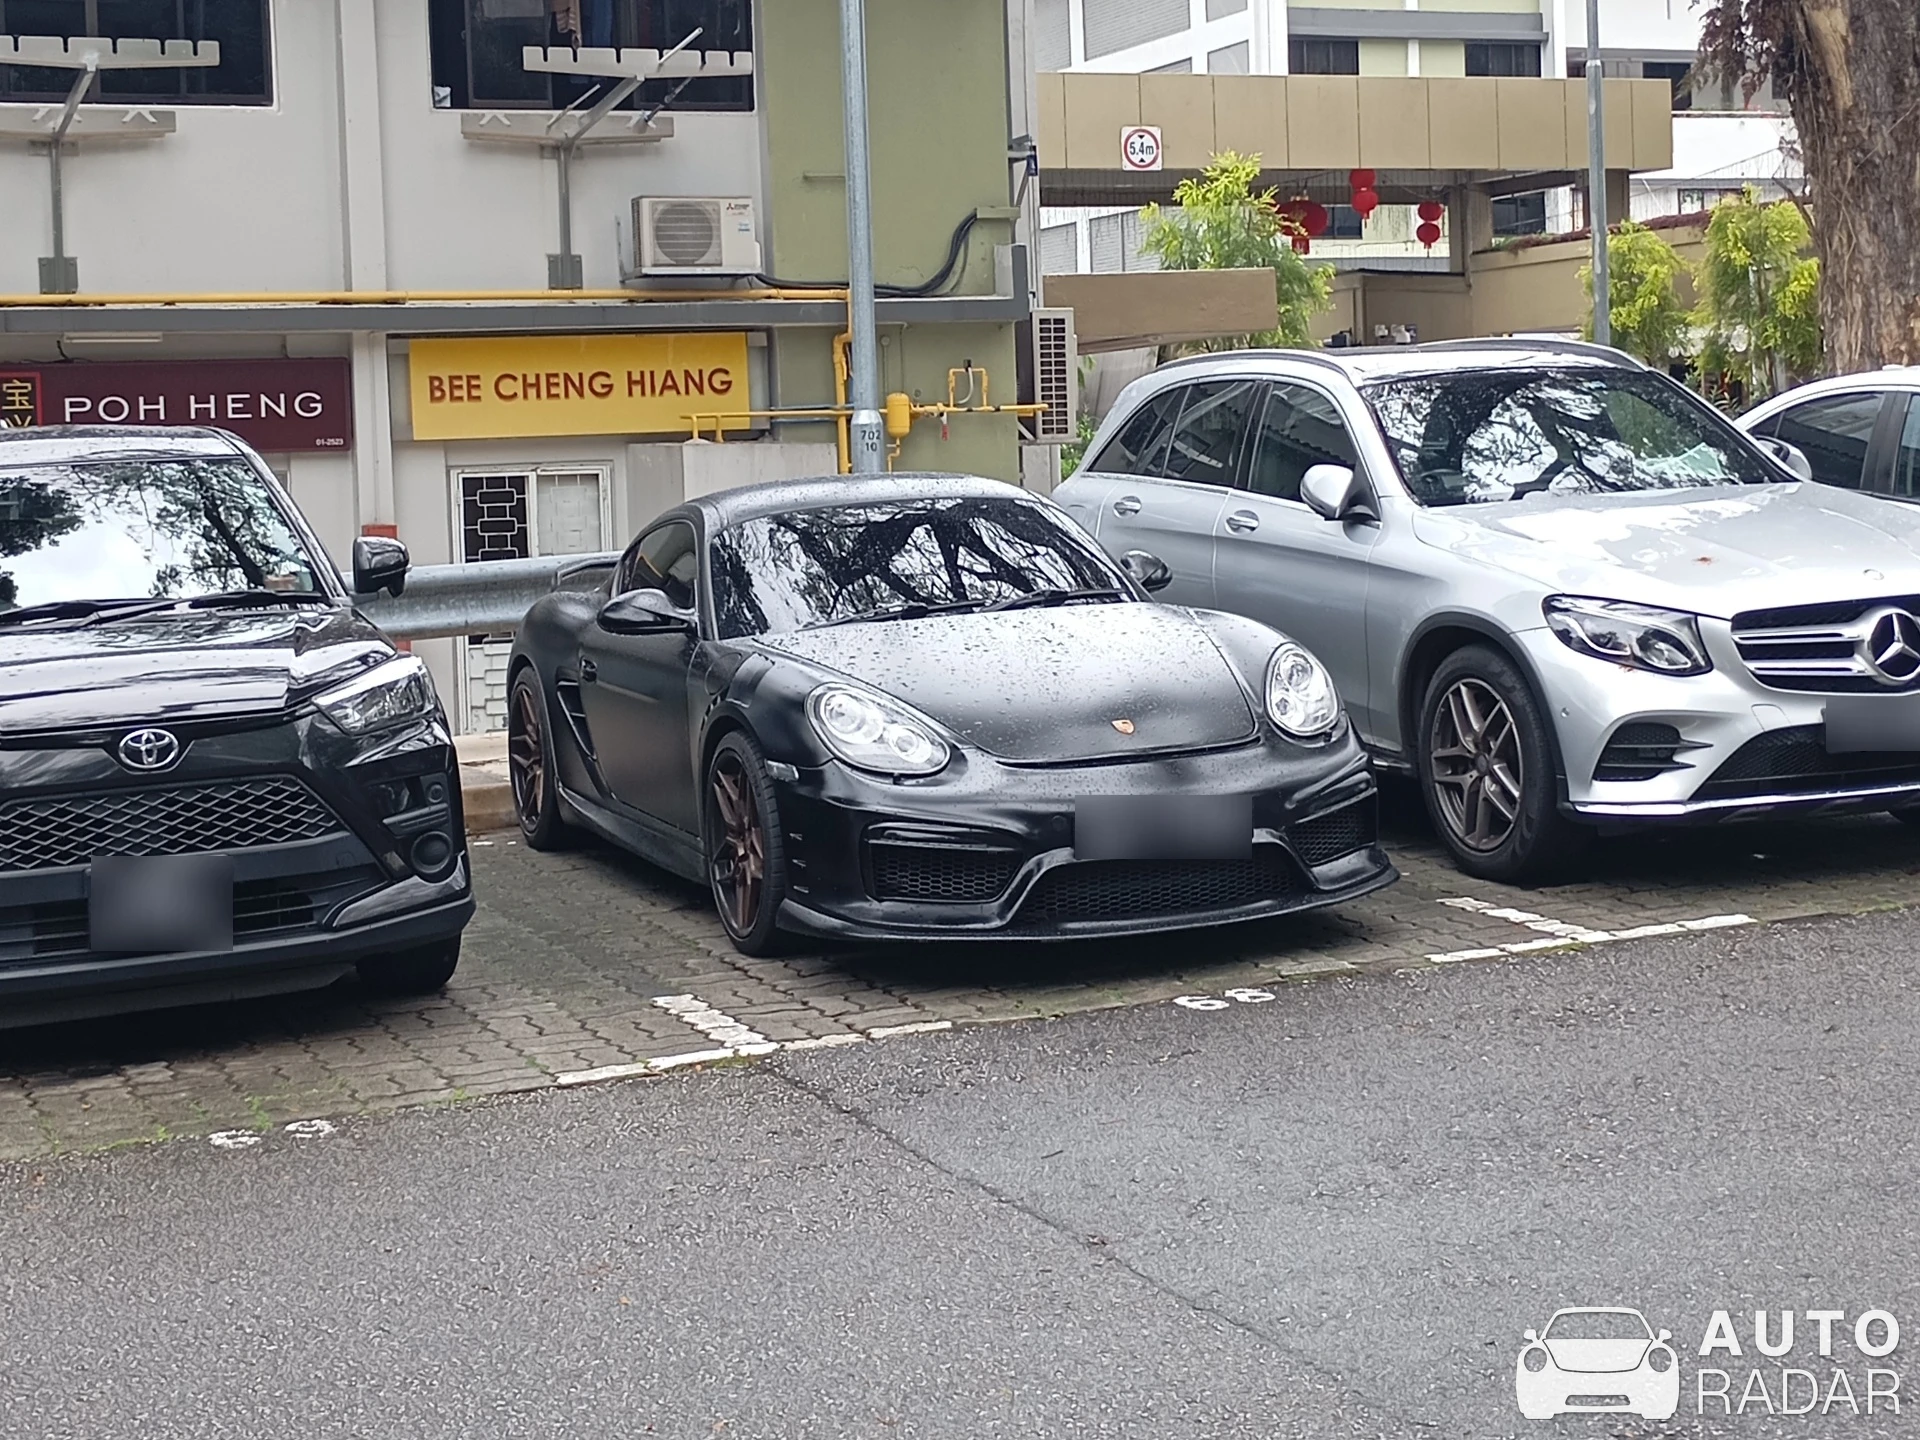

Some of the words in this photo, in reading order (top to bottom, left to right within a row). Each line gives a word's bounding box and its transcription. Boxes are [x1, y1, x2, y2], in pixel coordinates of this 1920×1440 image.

[1129, 141, 1155, 156] 5.4m
[428, 373, 482, 403] BEE
[494, 370, 614, 402] CHENG
[626, 367, 733, 397] HIANG
[64, 395, 166, 423] POH
[189, 391, 324, 420] HENG
[315, 437, 344, 446] 01-2523
[860, 429, 881, 441] 702
[865, 441, 878, 452] 10
[1172, 987, 1277, 1011] 68
